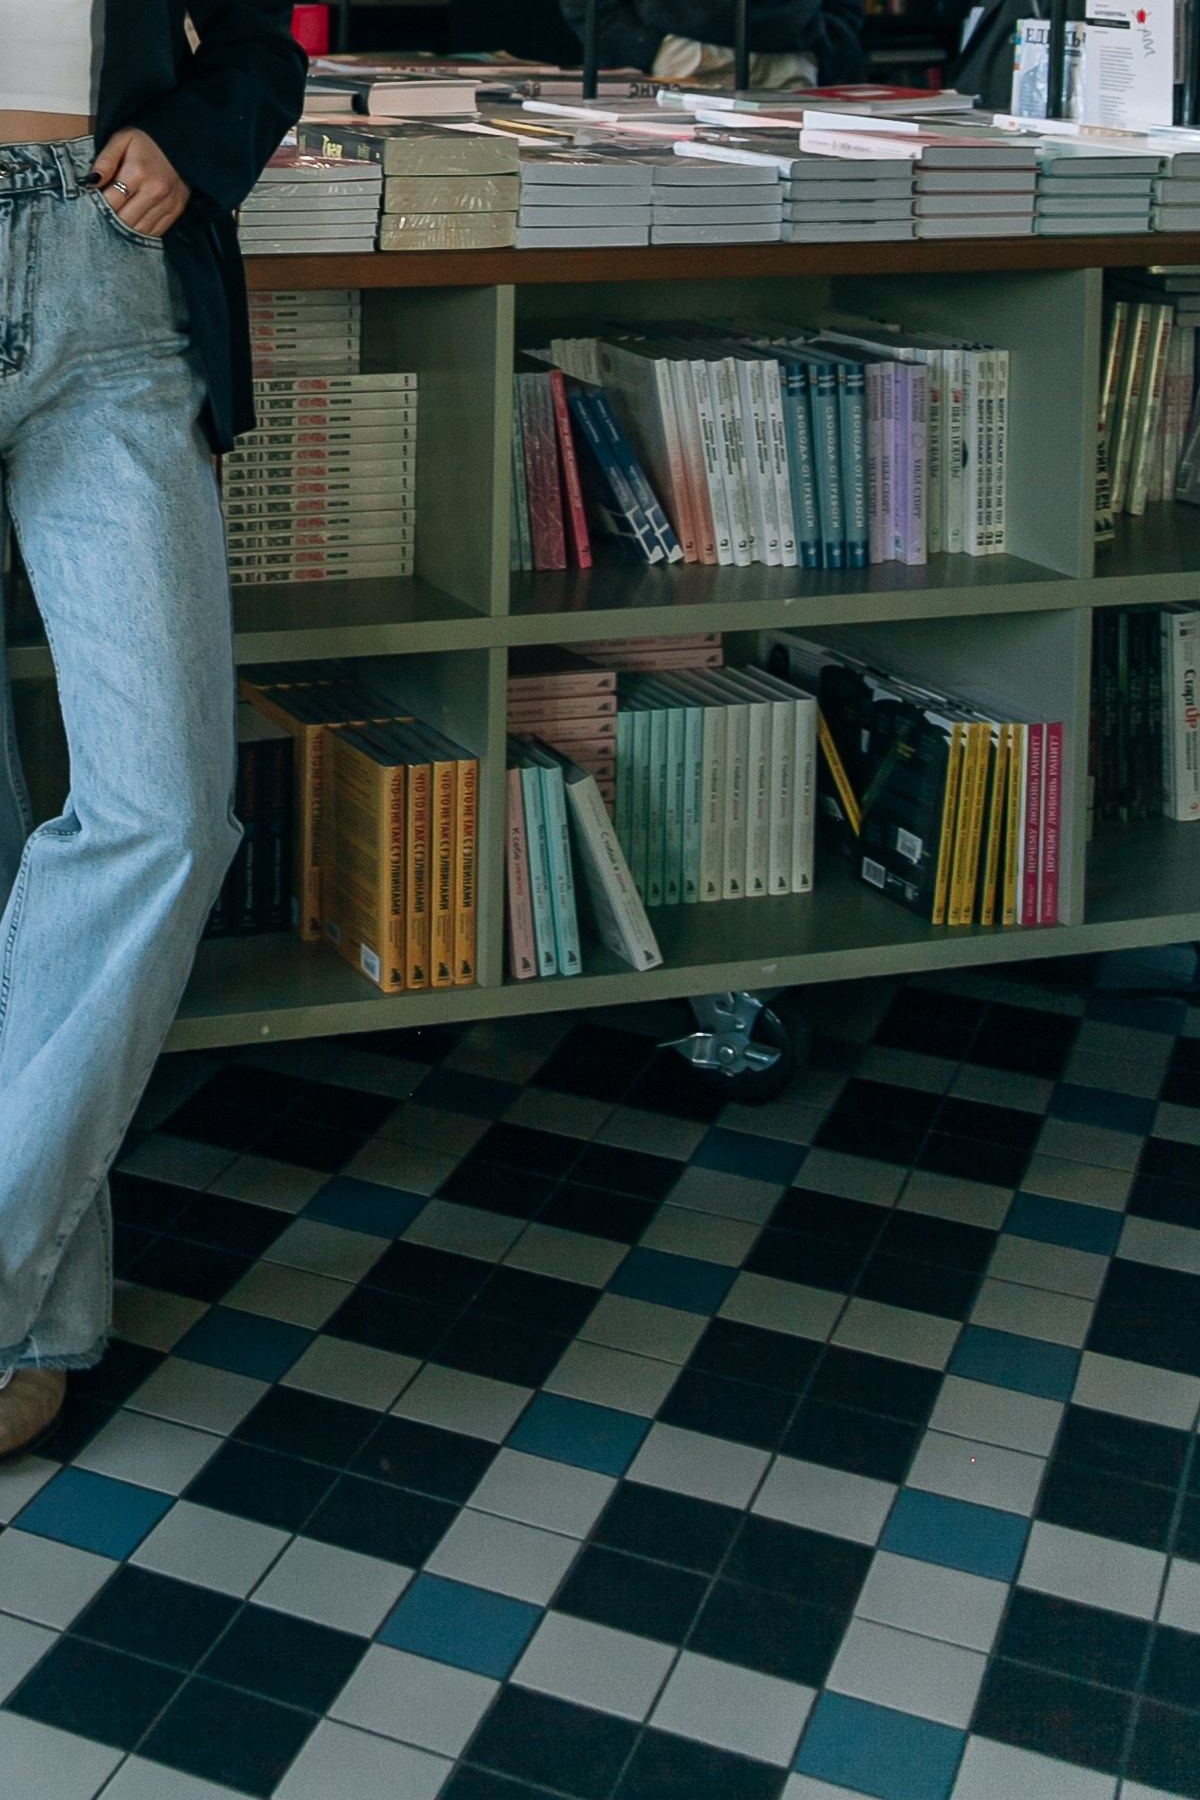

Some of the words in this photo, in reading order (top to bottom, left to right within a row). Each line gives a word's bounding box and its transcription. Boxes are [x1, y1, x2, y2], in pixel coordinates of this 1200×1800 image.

[390, 774, 401, 810] ЧТО-ТО
[415, 773, 426, 808] ЧТО-ТО
[440, 771, 451, 806] ЧТО-ТО
[464, 768, 474, 803] ЧТО-ТО
[1029, 778, 1040, 825] ЛЮБОВЬ
[1047, 778, 1057, 825] ЛЮБОВЬ
[390, 811, 401, 824] НЕ
[414, 809, 425, 822] НЕ
[440, 807, 451, 821] НЕ
[464, 804, 474, 817] НЕ
[390, 825, 401, 843] ТАК
[414, 824, 425, 842] ТАК
[440, 822, 451, 839] ТАК
[464, 820, 474, 837] ТАК
[1028, 828, 1039, 873] ПОЧЕМУ
[1046, 827, 1056, 872] ПОЧЕМУ
[390, 852, 401, 916] ГЭЛВИНАМИ
[414, 850, 425, 914] ГЭЛВИНАМИ
[439, 848, 450, 911] ГЭЛВИНАМИ
[463, 845, 473, 908] ГЭЛВИНАМИ
